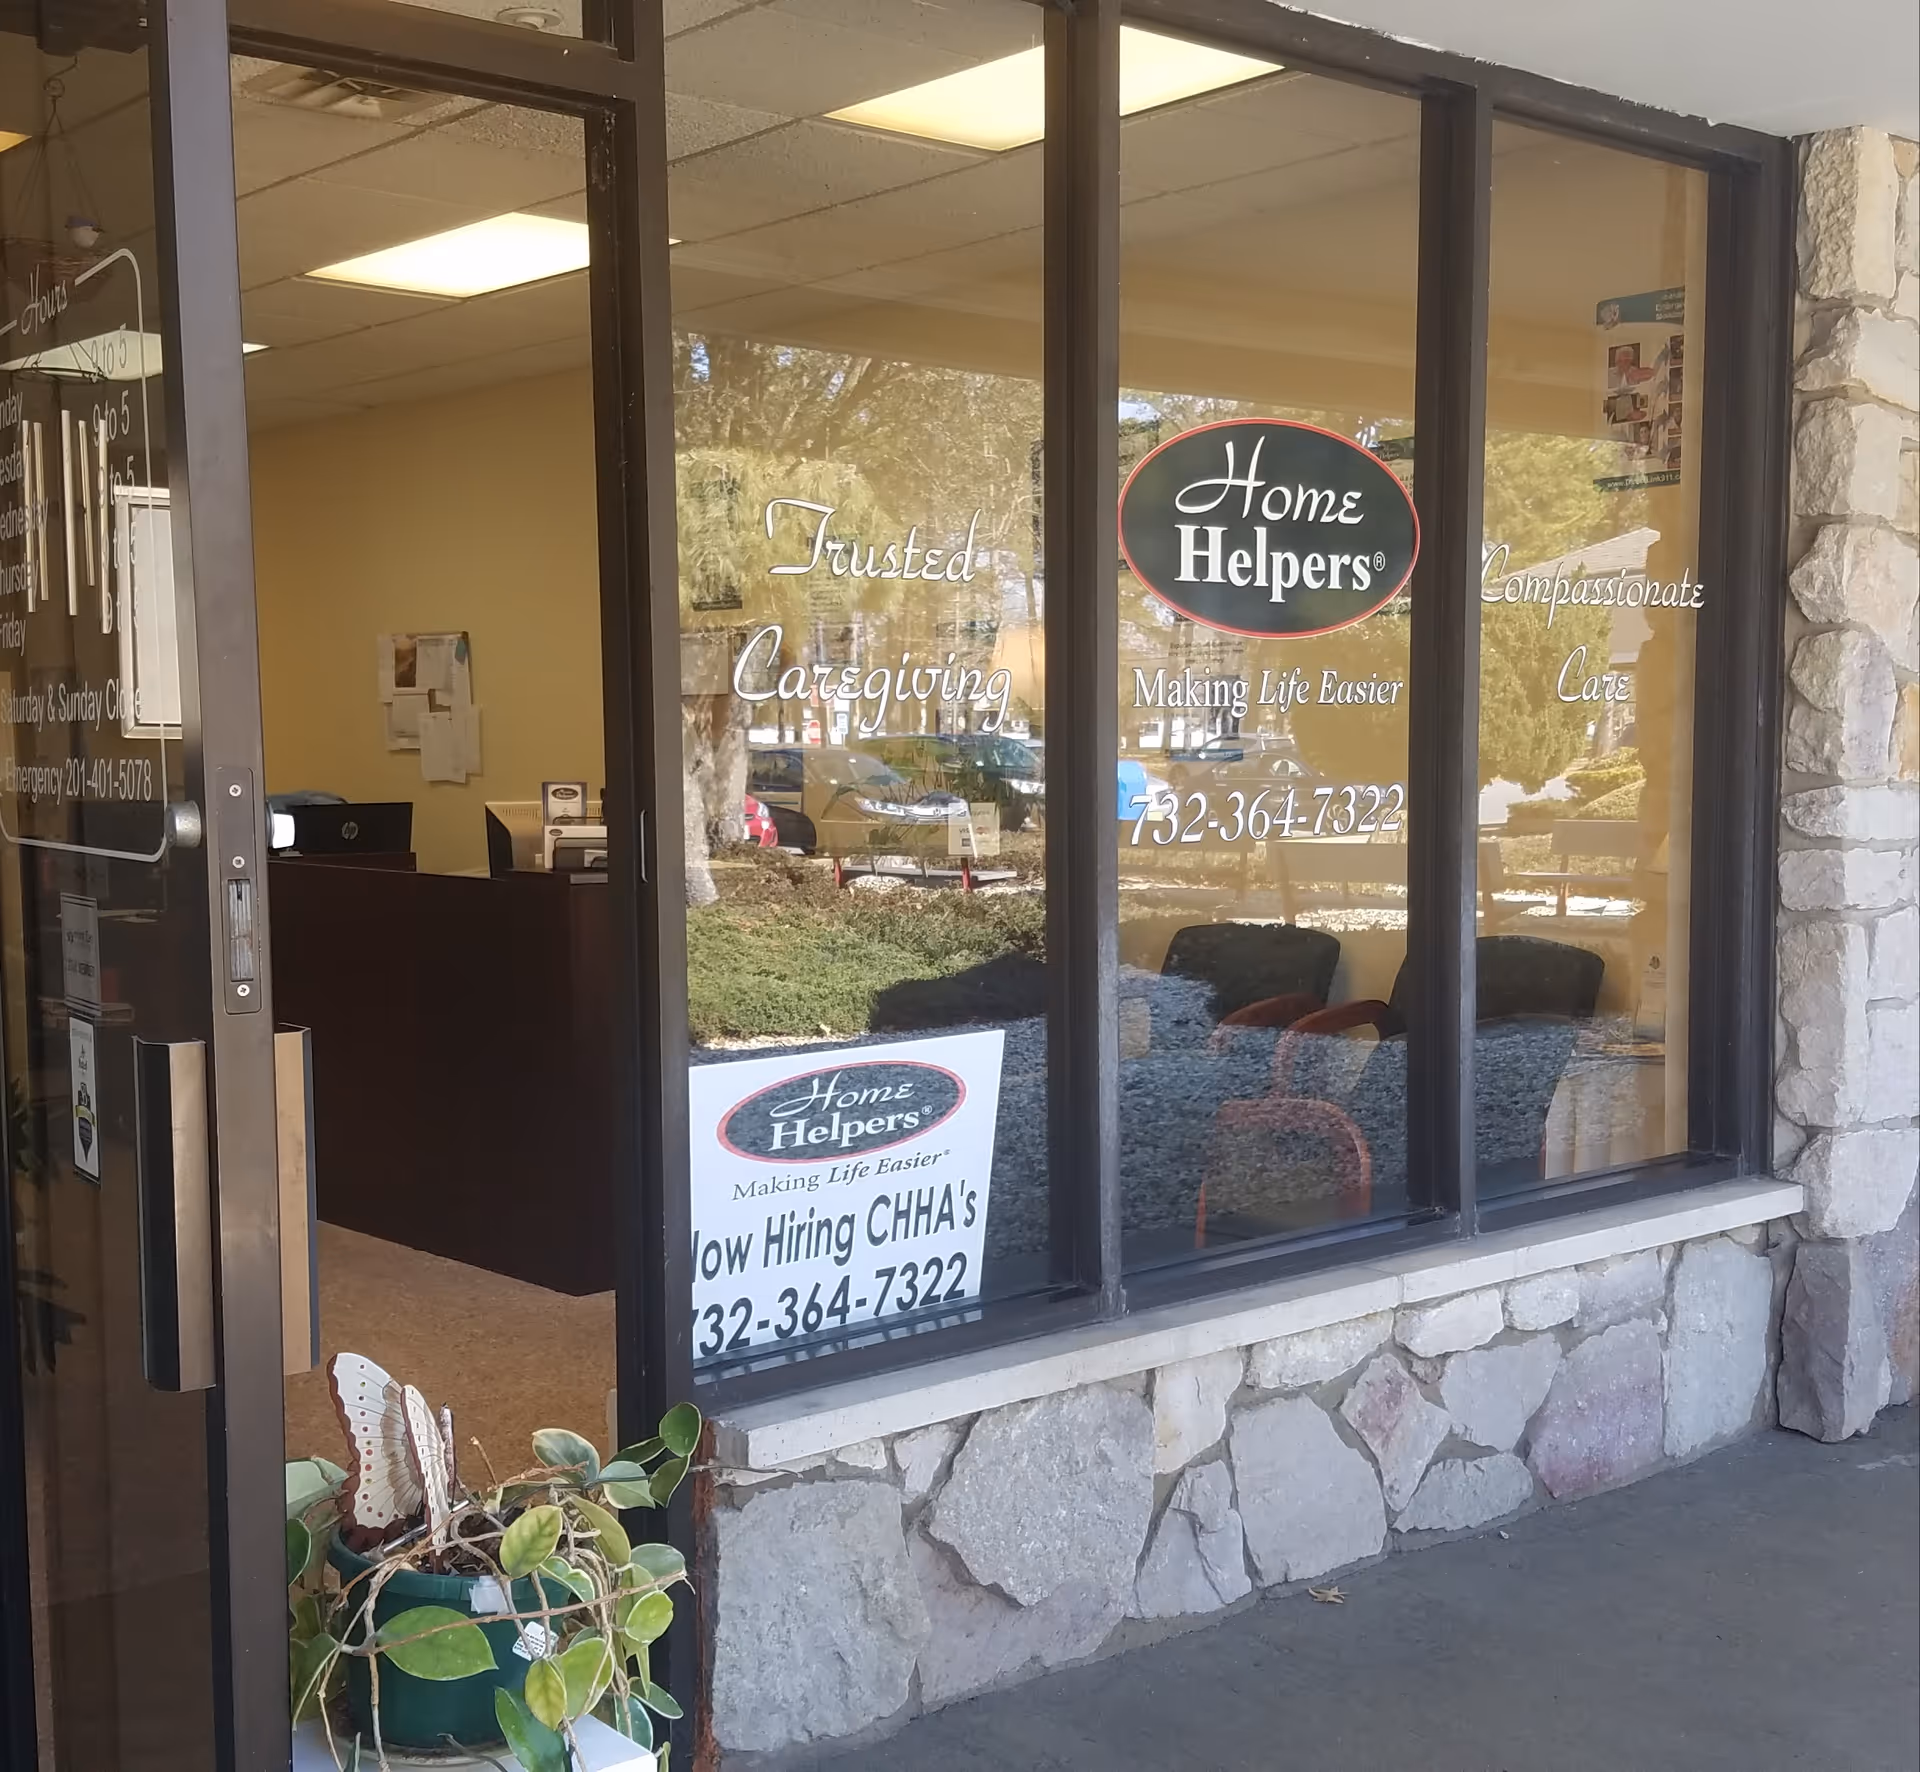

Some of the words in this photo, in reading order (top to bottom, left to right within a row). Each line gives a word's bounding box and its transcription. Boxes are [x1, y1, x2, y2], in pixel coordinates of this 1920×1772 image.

[21, 264, 68, 335] Hours
[103, 337, 115, 376] to
[119, 322, 127, 368] 5
[105, 399, 118, 442] to
[121, 389, 130, 436] 5
[1175, 436, 1364, 524] Home
[765, 498, 982, 582] Trusted
[1480, 543, 1705, 630] Compassionate
[732, 625, 1012, 733] Caregiving
[1132, 667, 1249, 718] Making
[1256, 667, 1310, 713] Life
[1317, 670, 1404, 706] Easier
[1557, 645, 1631, 703] Care
[0, 685, 44, 733] Saturday
[47, 684, 56, 723] &
[58, 680, 102, 732] Sunday
[6, 757, 63, 805] Emergency
[66, 757, 152, 802] 201-401-5078
[1128, 783, 1405, 846] 732-364-7322
[769, 1070, 914, 1118] Home
[732, 1173, 820, 1201] Making
[827, 1162, 869, 1188] Life
[763, 1206, 856, 1267] Hiring
[866, 1179, 977, 1247] CHHA's
